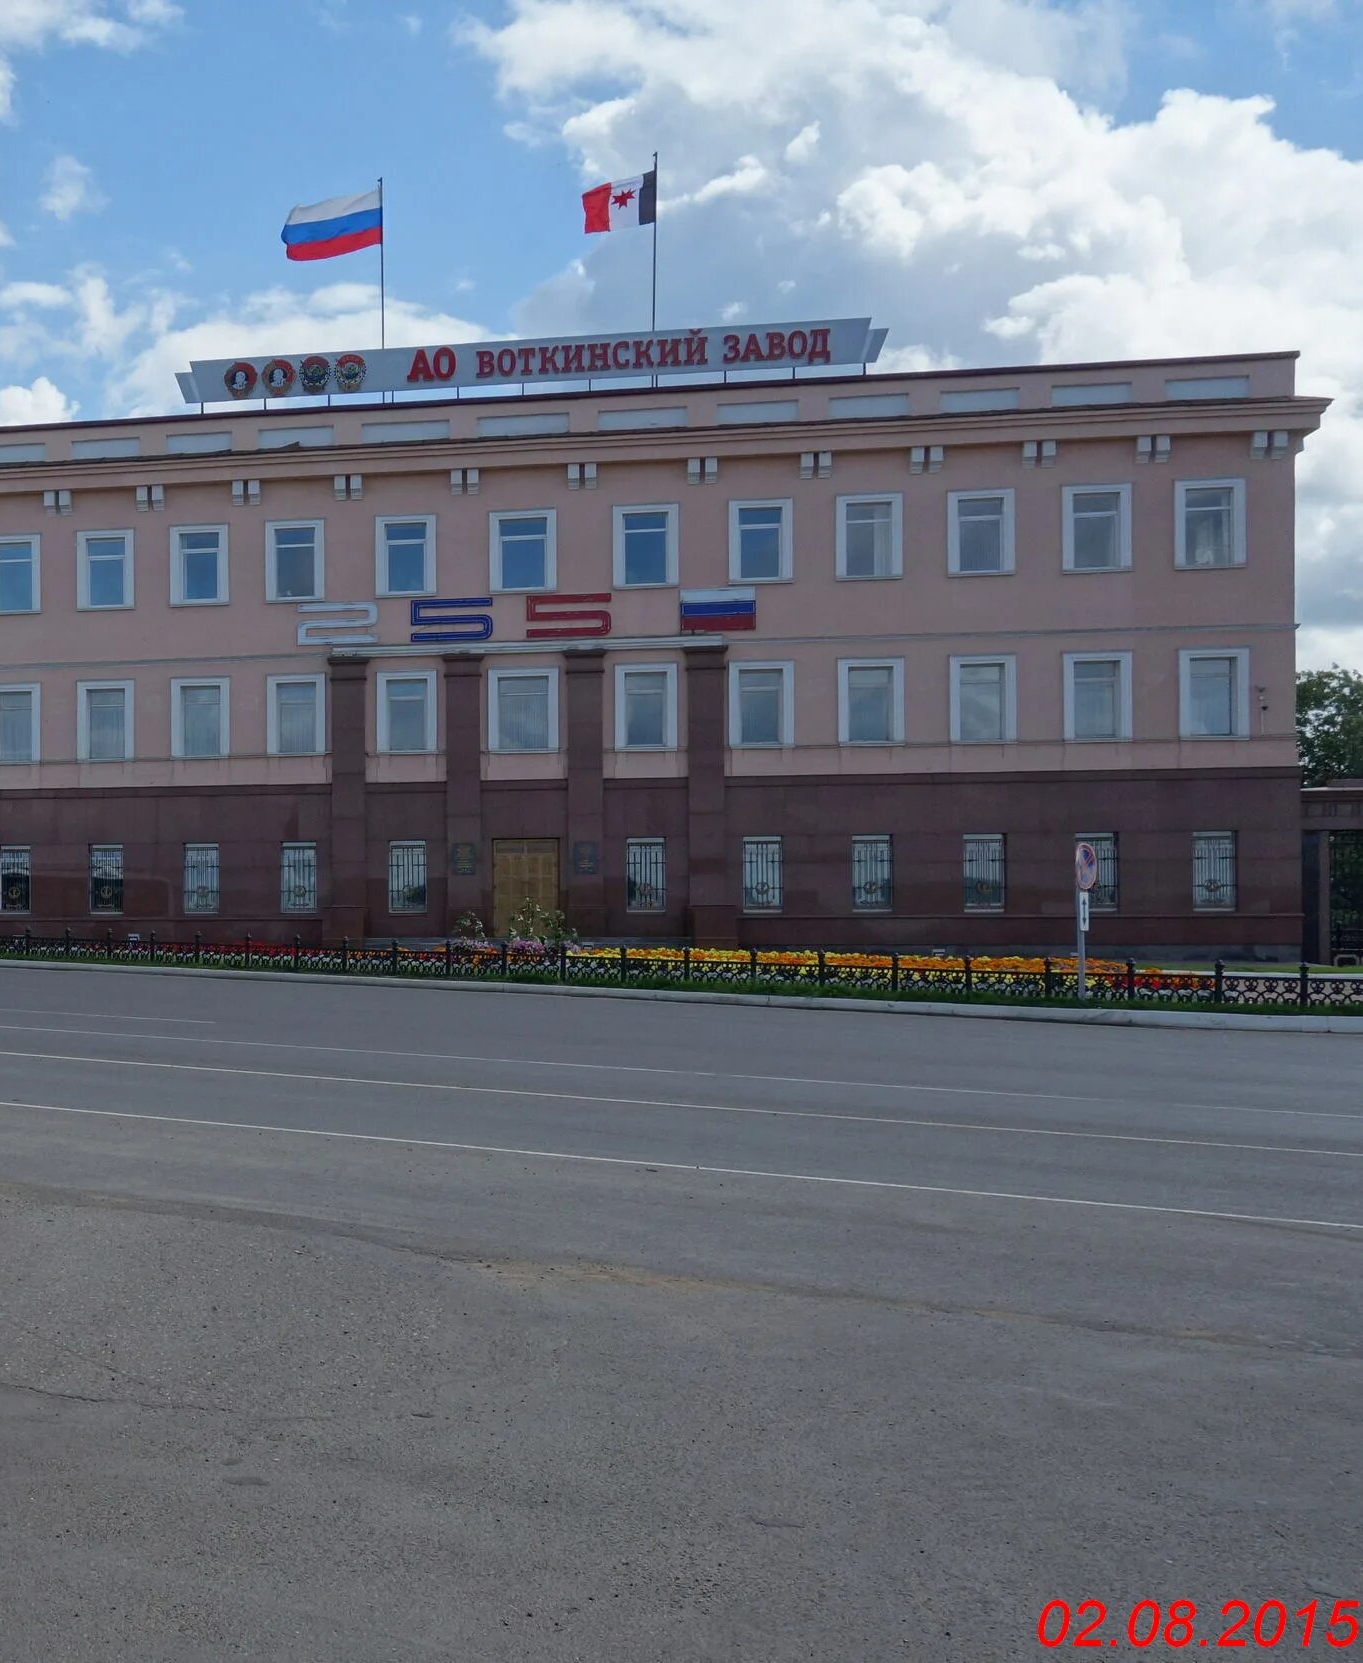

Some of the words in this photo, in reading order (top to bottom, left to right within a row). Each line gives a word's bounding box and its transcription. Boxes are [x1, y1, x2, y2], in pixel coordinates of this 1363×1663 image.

[407, 346, 456, 382] АО
[476, 329, 709, 378] ВОТКИНСКИЙ
[723, 328, 832, 365] ЗАВОД
